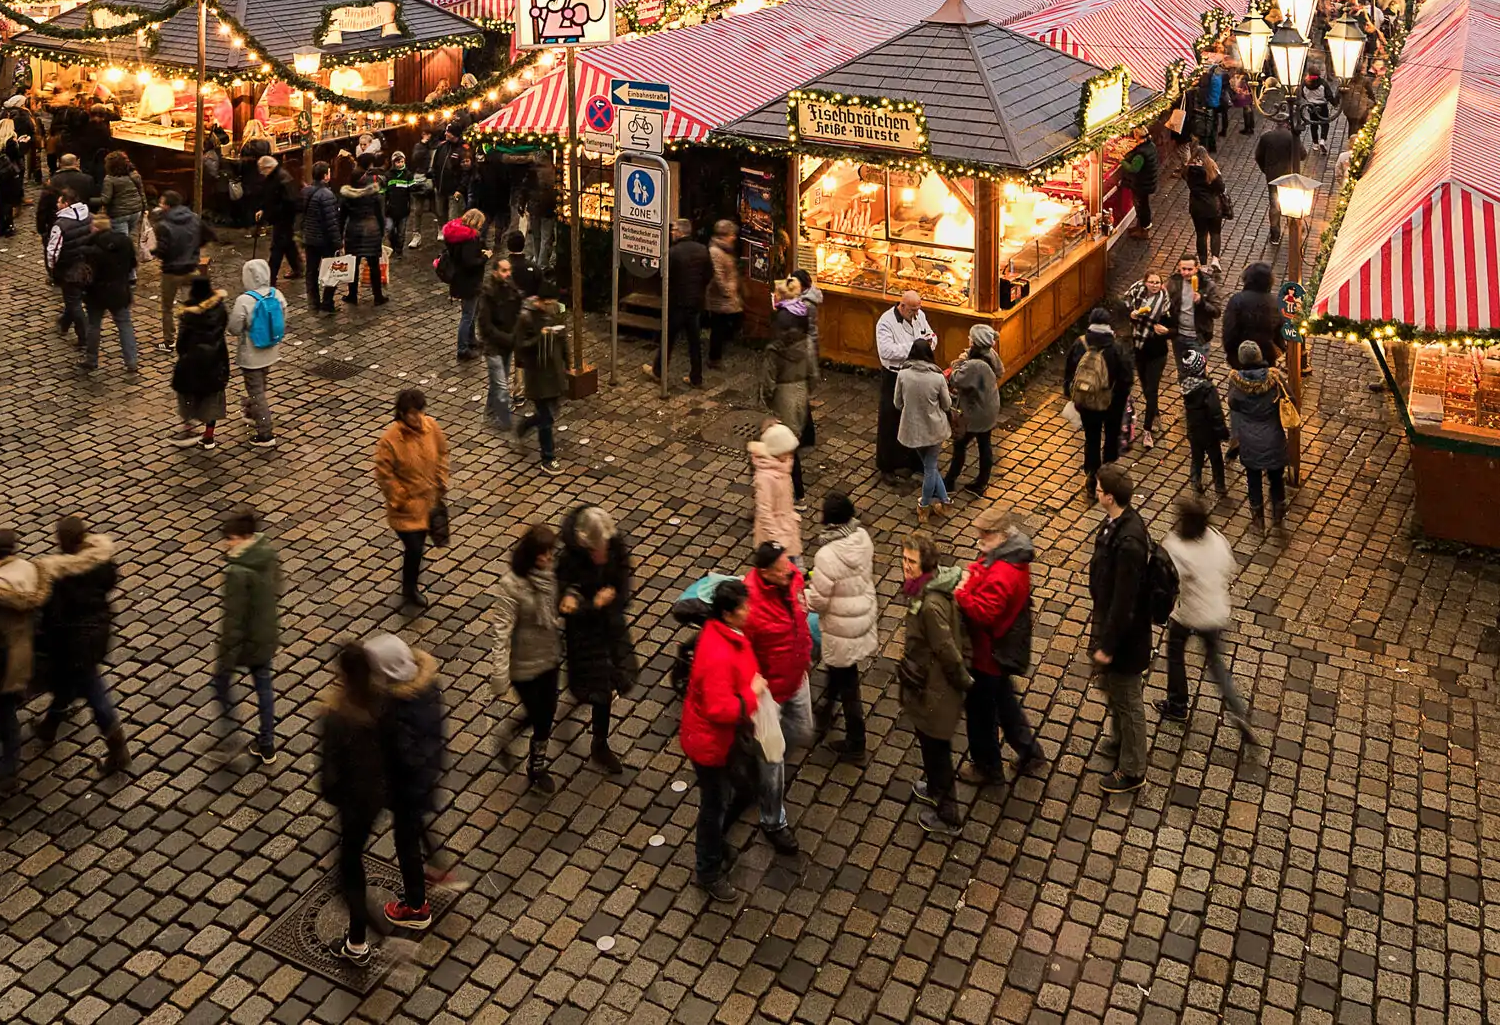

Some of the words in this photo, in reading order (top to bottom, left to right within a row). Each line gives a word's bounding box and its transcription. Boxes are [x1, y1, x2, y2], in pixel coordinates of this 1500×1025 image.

[627, 90, 667, 101] Einbahnstraße
[807, 103, 911, 131] Fischbrötchen
[629, 206, 652, 220] ZONE
[1285, 328, 1297, 337] WC
